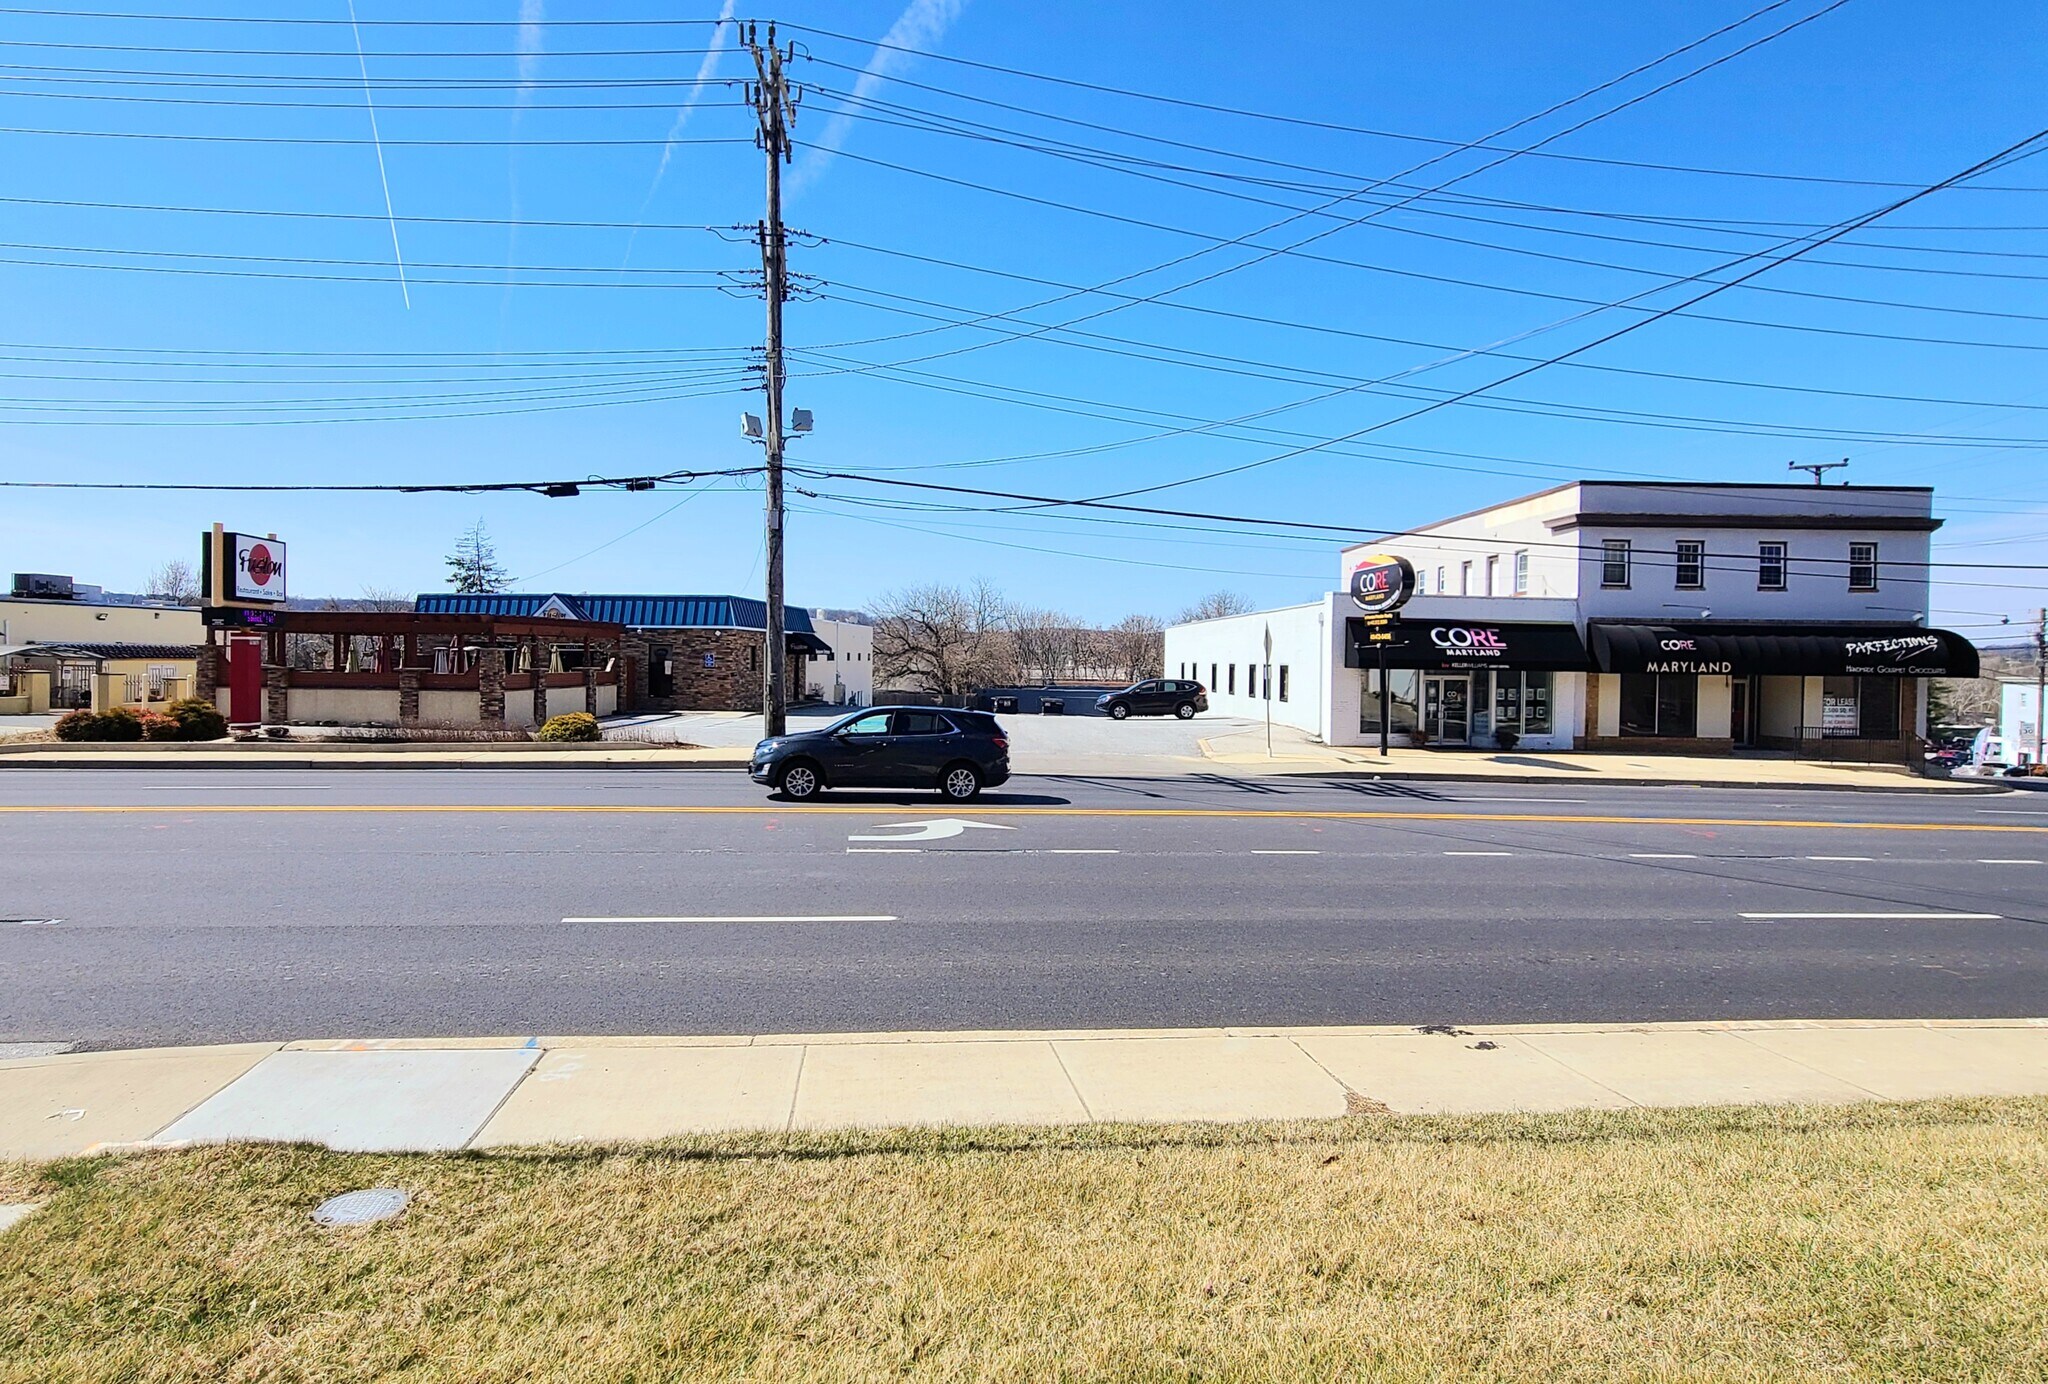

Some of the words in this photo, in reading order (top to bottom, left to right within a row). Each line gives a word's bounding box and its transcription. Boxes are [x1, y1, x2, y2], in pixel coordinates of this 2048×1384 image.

[239, 549, 282, 577] Fusion
[1360, 570, 1389, 592] CORE
[1430, 627, 1507, 647] CORE
[1660, 640, 1697, 650] CORE
[1845, 635, 1938, 656] PARFECTIONS
[1646, 661, 1732, 673] MARYLAND
[1837, 698, 1855, 706] LEASE
